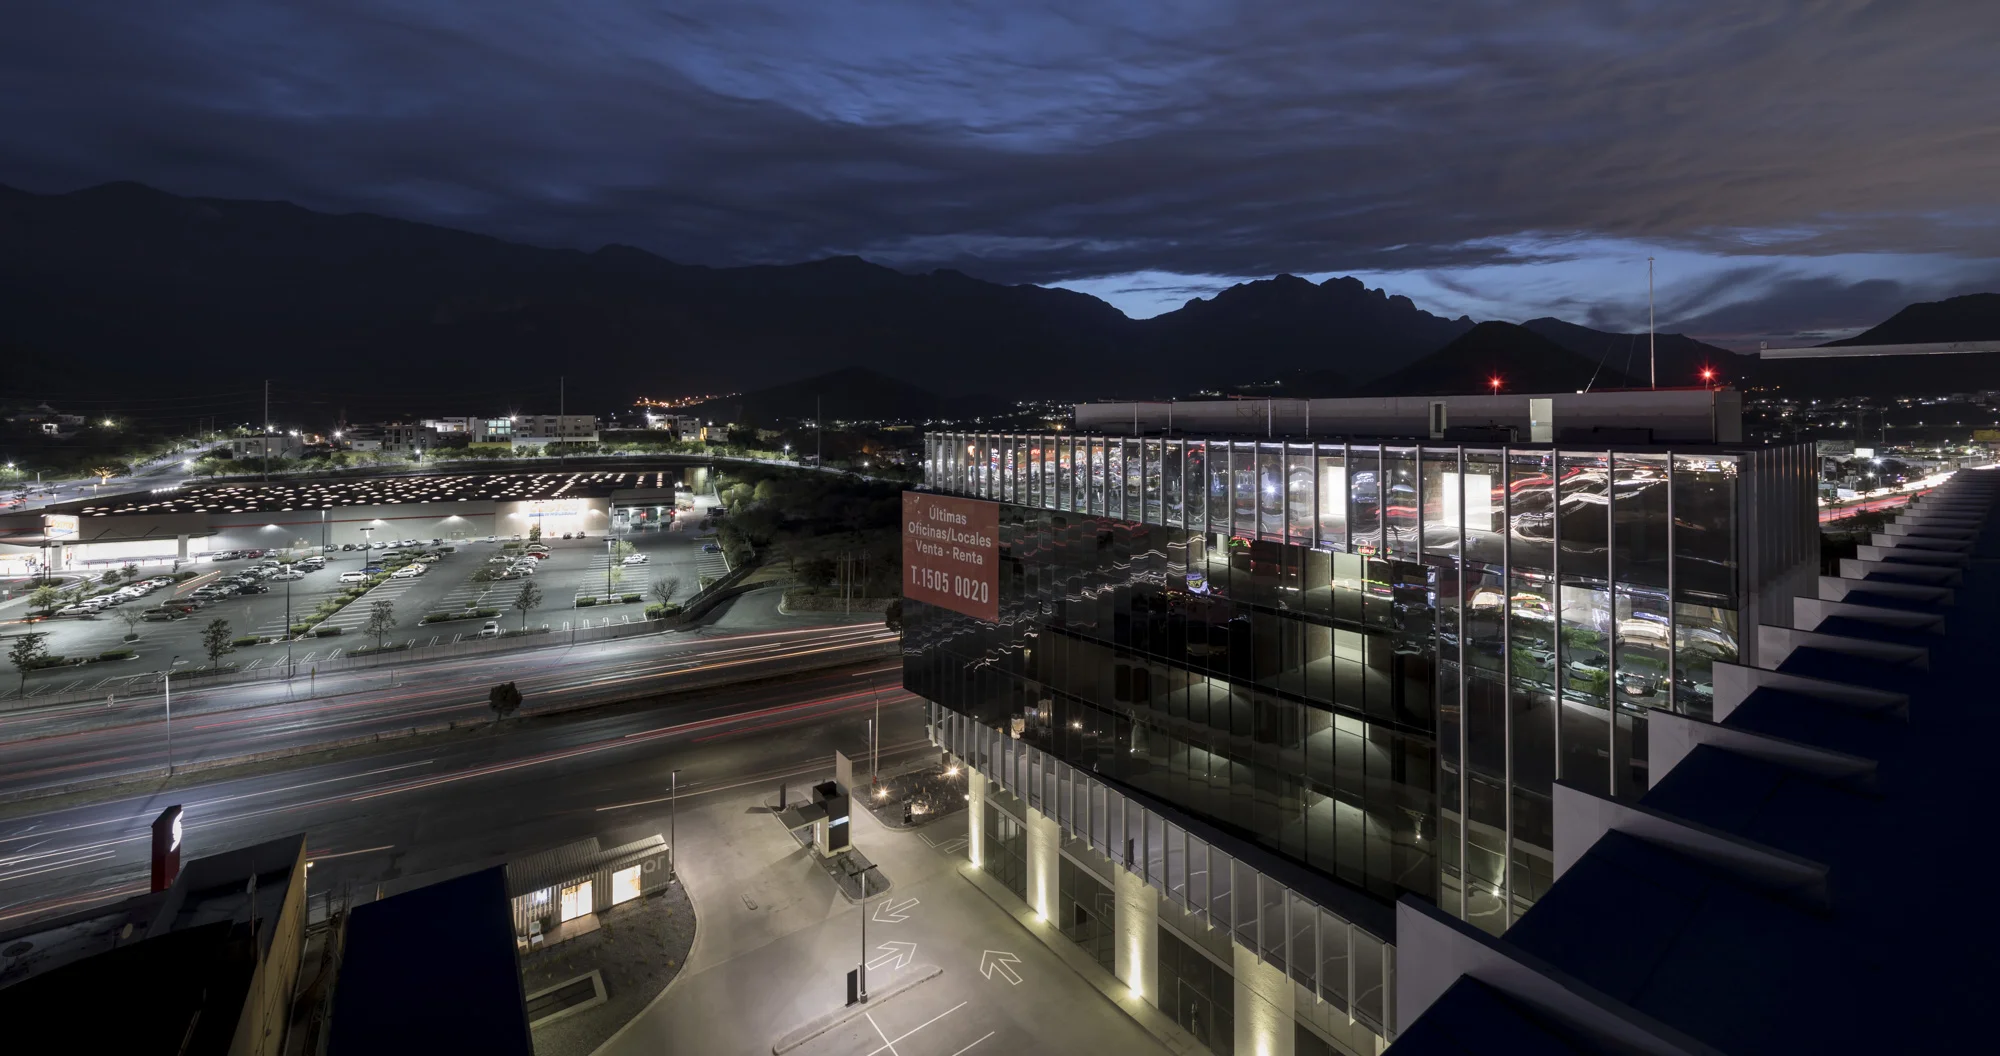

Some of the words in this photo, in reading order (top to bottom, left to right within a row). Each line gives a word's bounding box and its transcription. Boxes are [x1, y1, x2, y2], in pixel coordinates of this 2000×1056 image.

[929, 504, 967, 525] Últimas
[908, 521, 992, 548] Oficinas/Locales
[916, 539, 943, 557] Venta
[953, 546, 983, 565] Renta
[911, 565, 949, 593] T.1505
[955, 575, 989, 604] 0020
